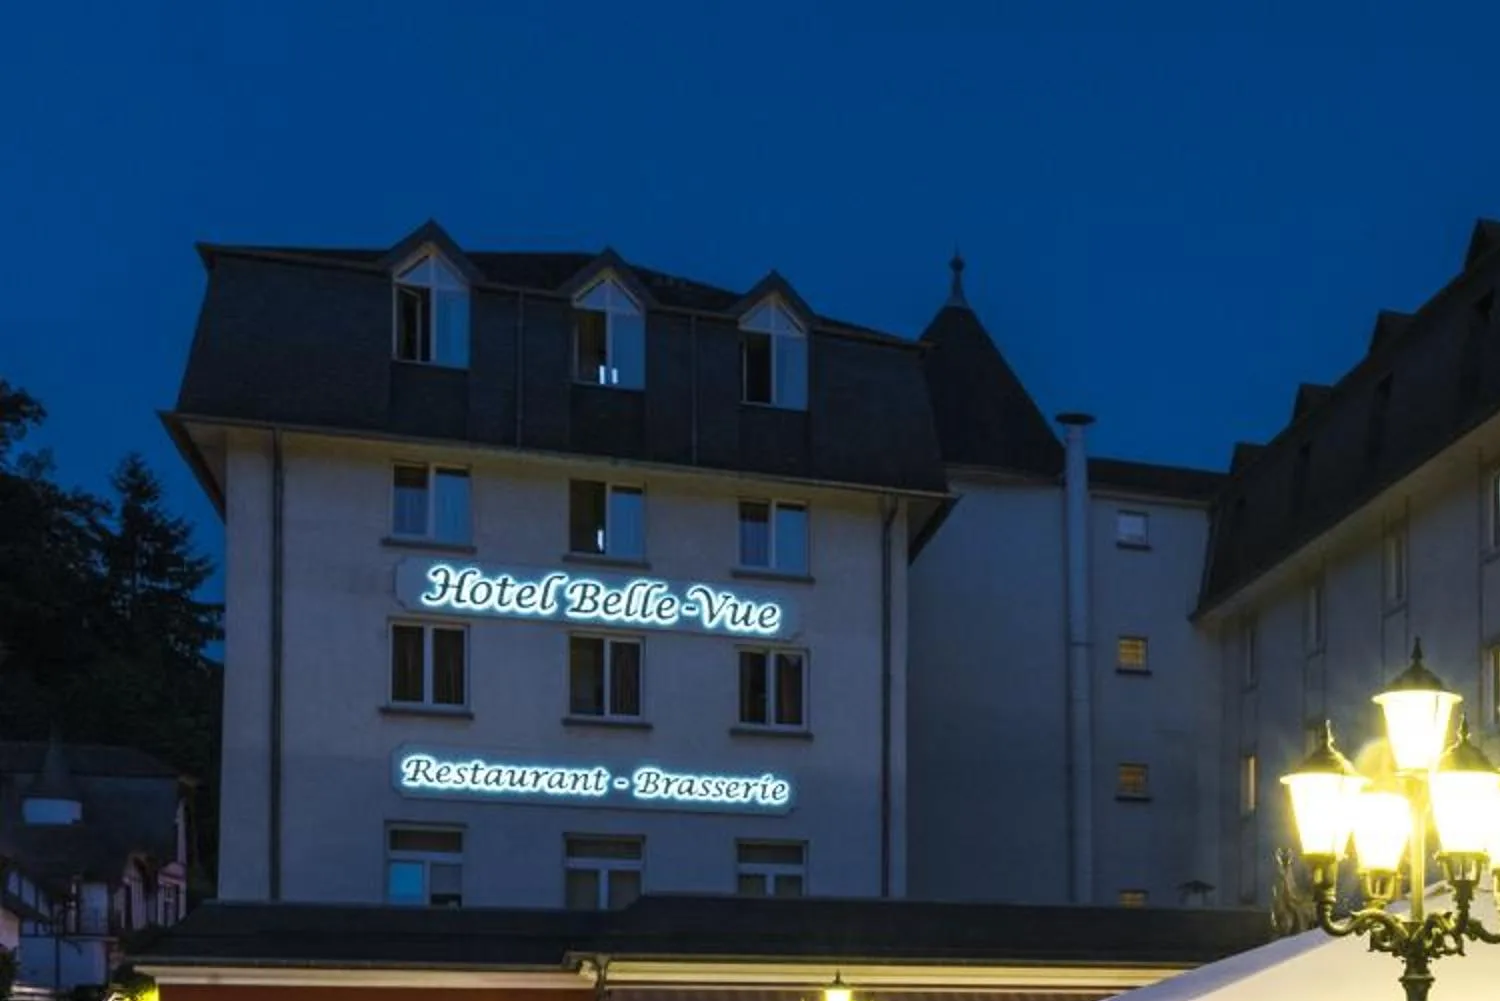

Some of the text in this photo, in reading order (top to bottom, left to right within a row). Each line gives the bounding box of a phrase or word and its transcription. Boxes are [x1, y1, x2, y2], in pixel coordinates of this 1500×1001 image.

[423, 565, 779, 630] Hotel Belle-Vue
[404, 757, 607, 793] Restaurant
[636, 769, 787, 802] Brasserie
